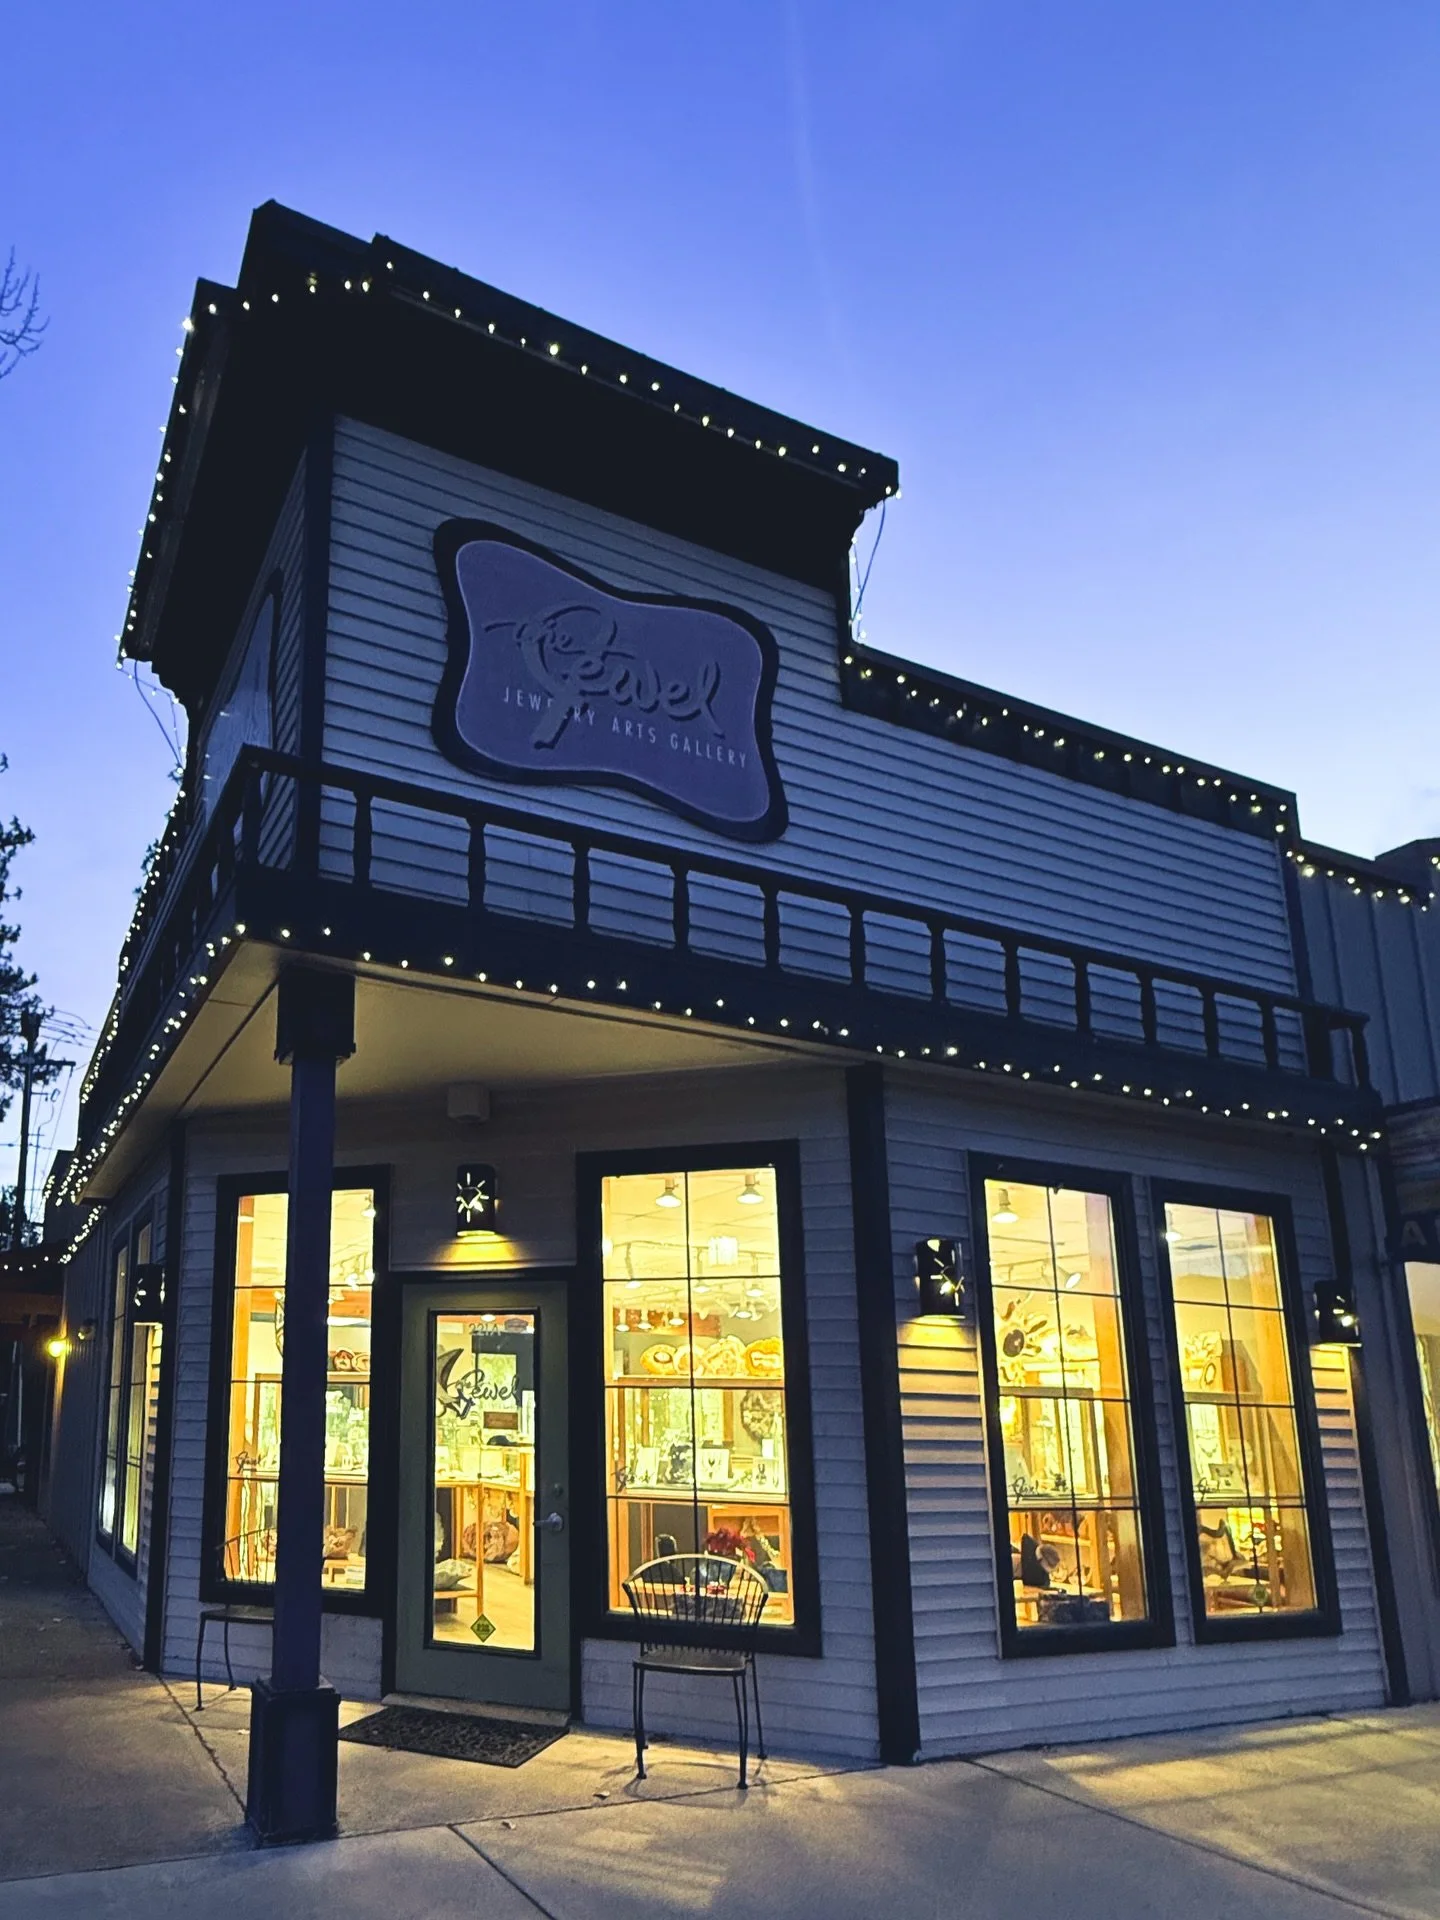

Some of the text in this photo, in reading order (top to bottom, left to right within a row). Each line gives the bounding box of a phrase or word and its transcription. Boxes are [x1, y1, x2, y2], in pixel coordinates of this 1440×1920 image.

[503, 686, 748, 769] JEWRY ARTS GALLERY
